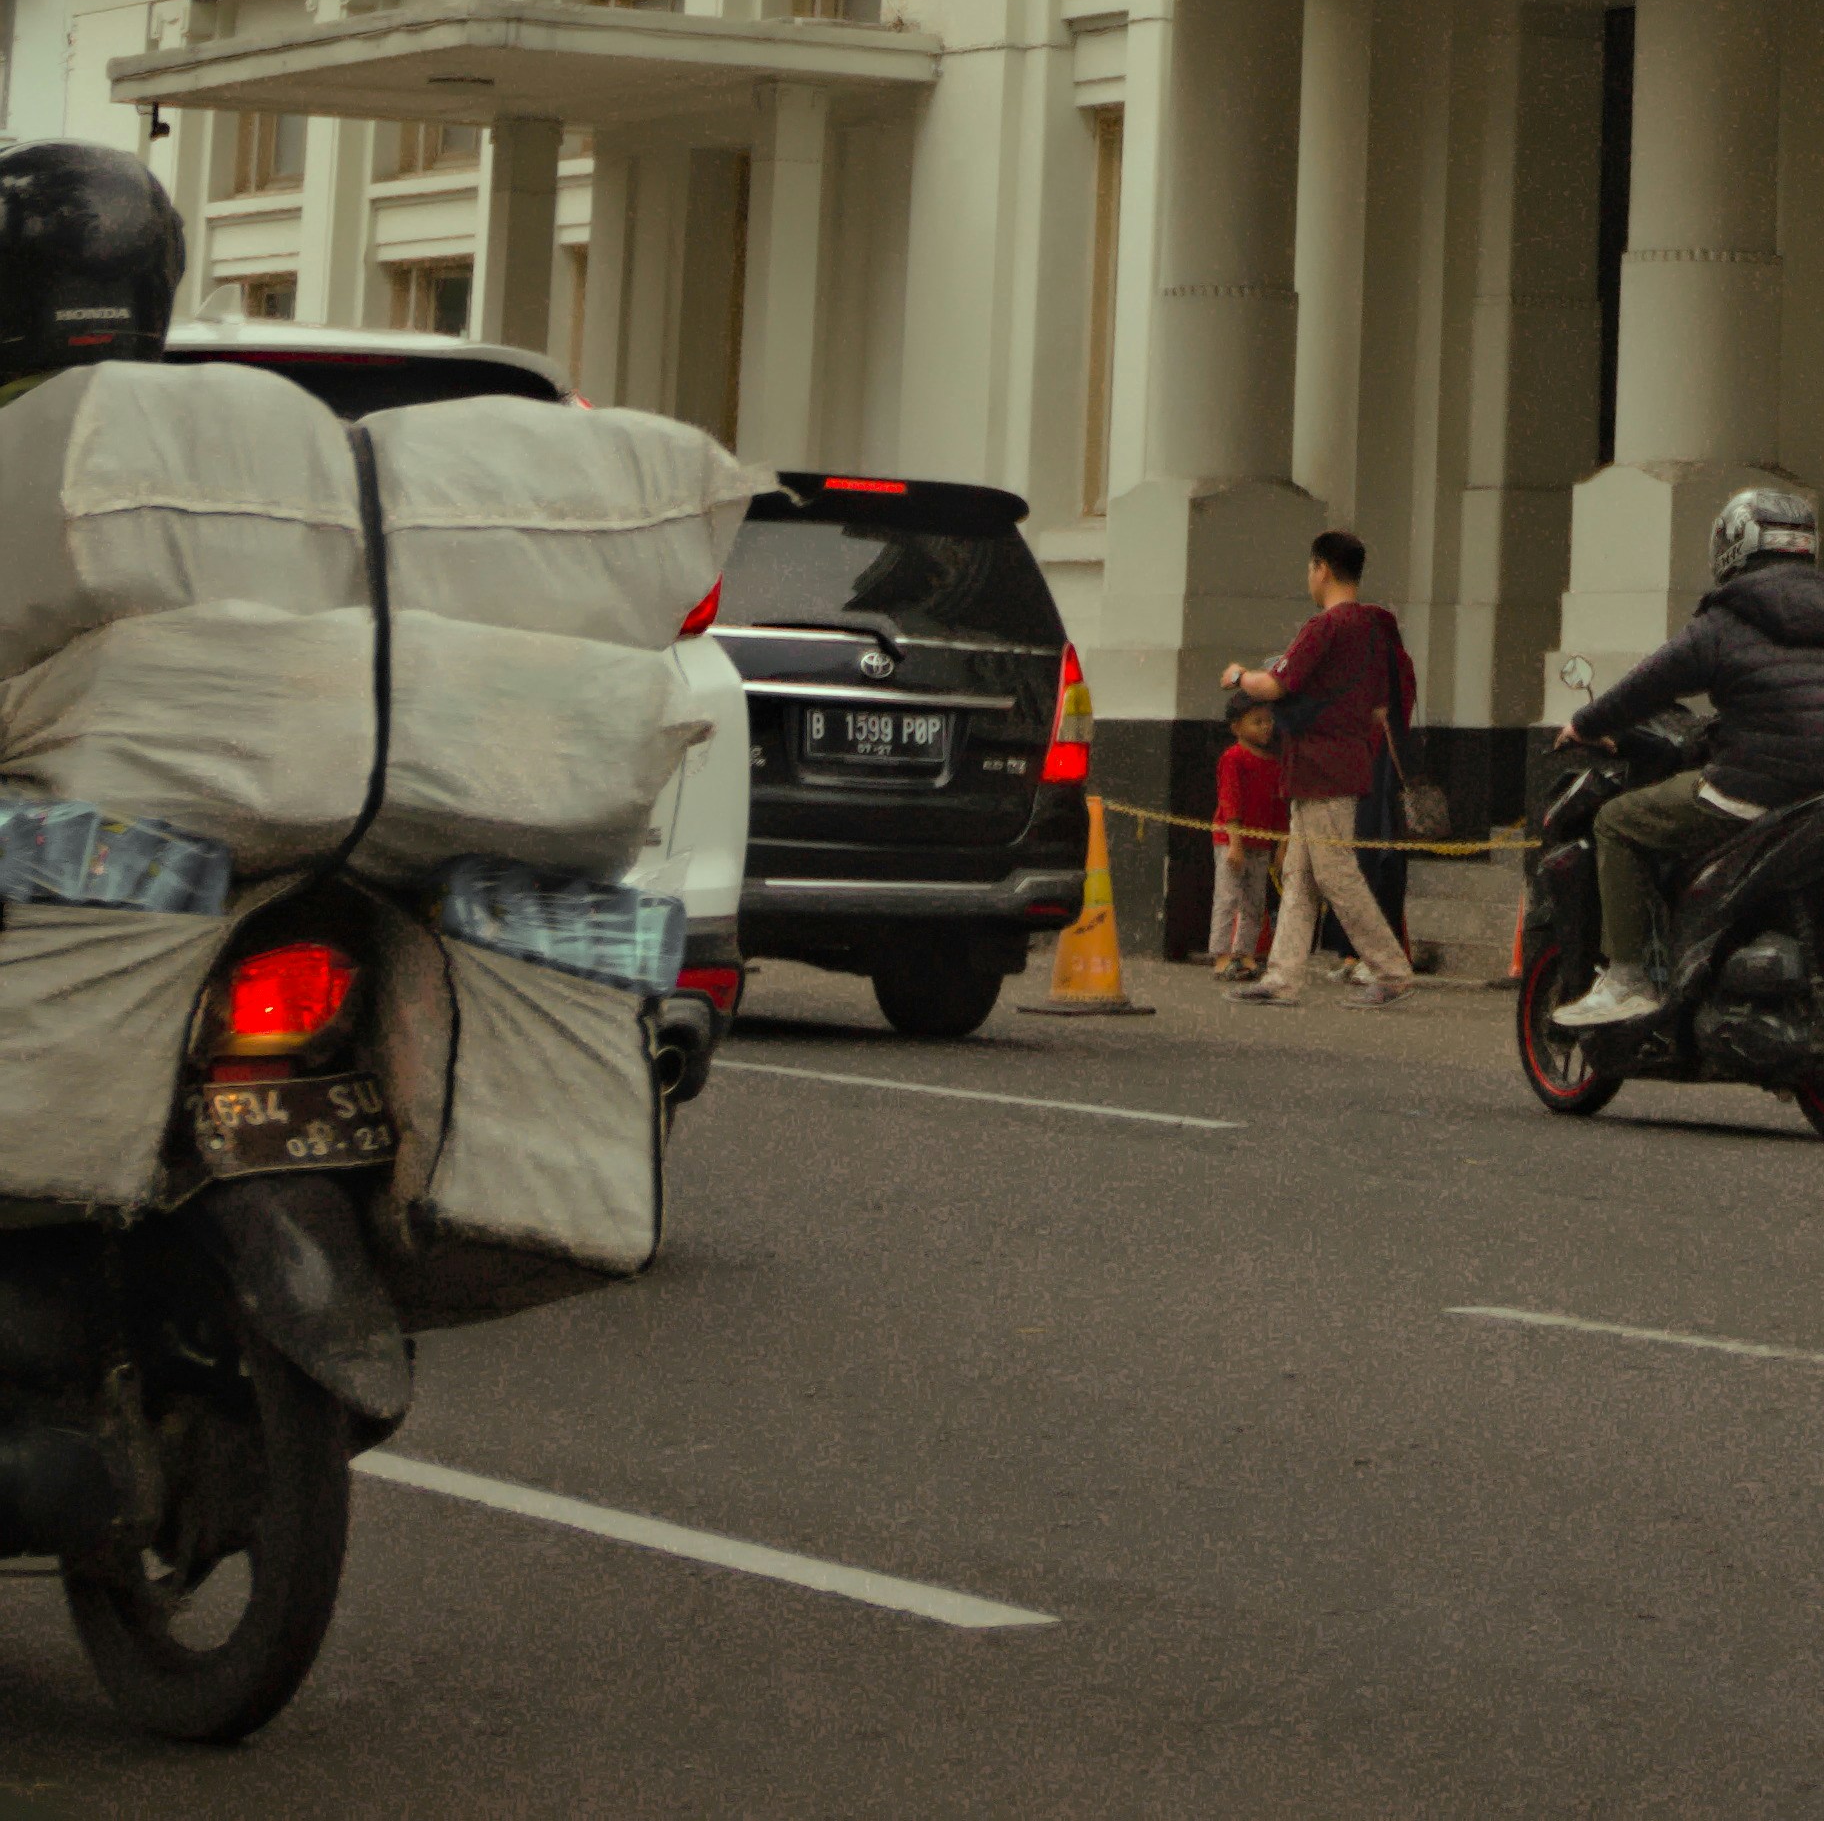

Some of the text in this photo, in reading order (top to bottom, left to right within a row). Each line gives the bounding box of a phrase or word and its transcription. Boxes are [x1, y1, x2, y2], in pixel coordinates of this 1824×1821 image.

[54, 306, 132, 322] HONDA
[811, 711, 825, 740] B
[845, 711, 894, 743] 1599
[327, 1079, 384, 1119] SU
